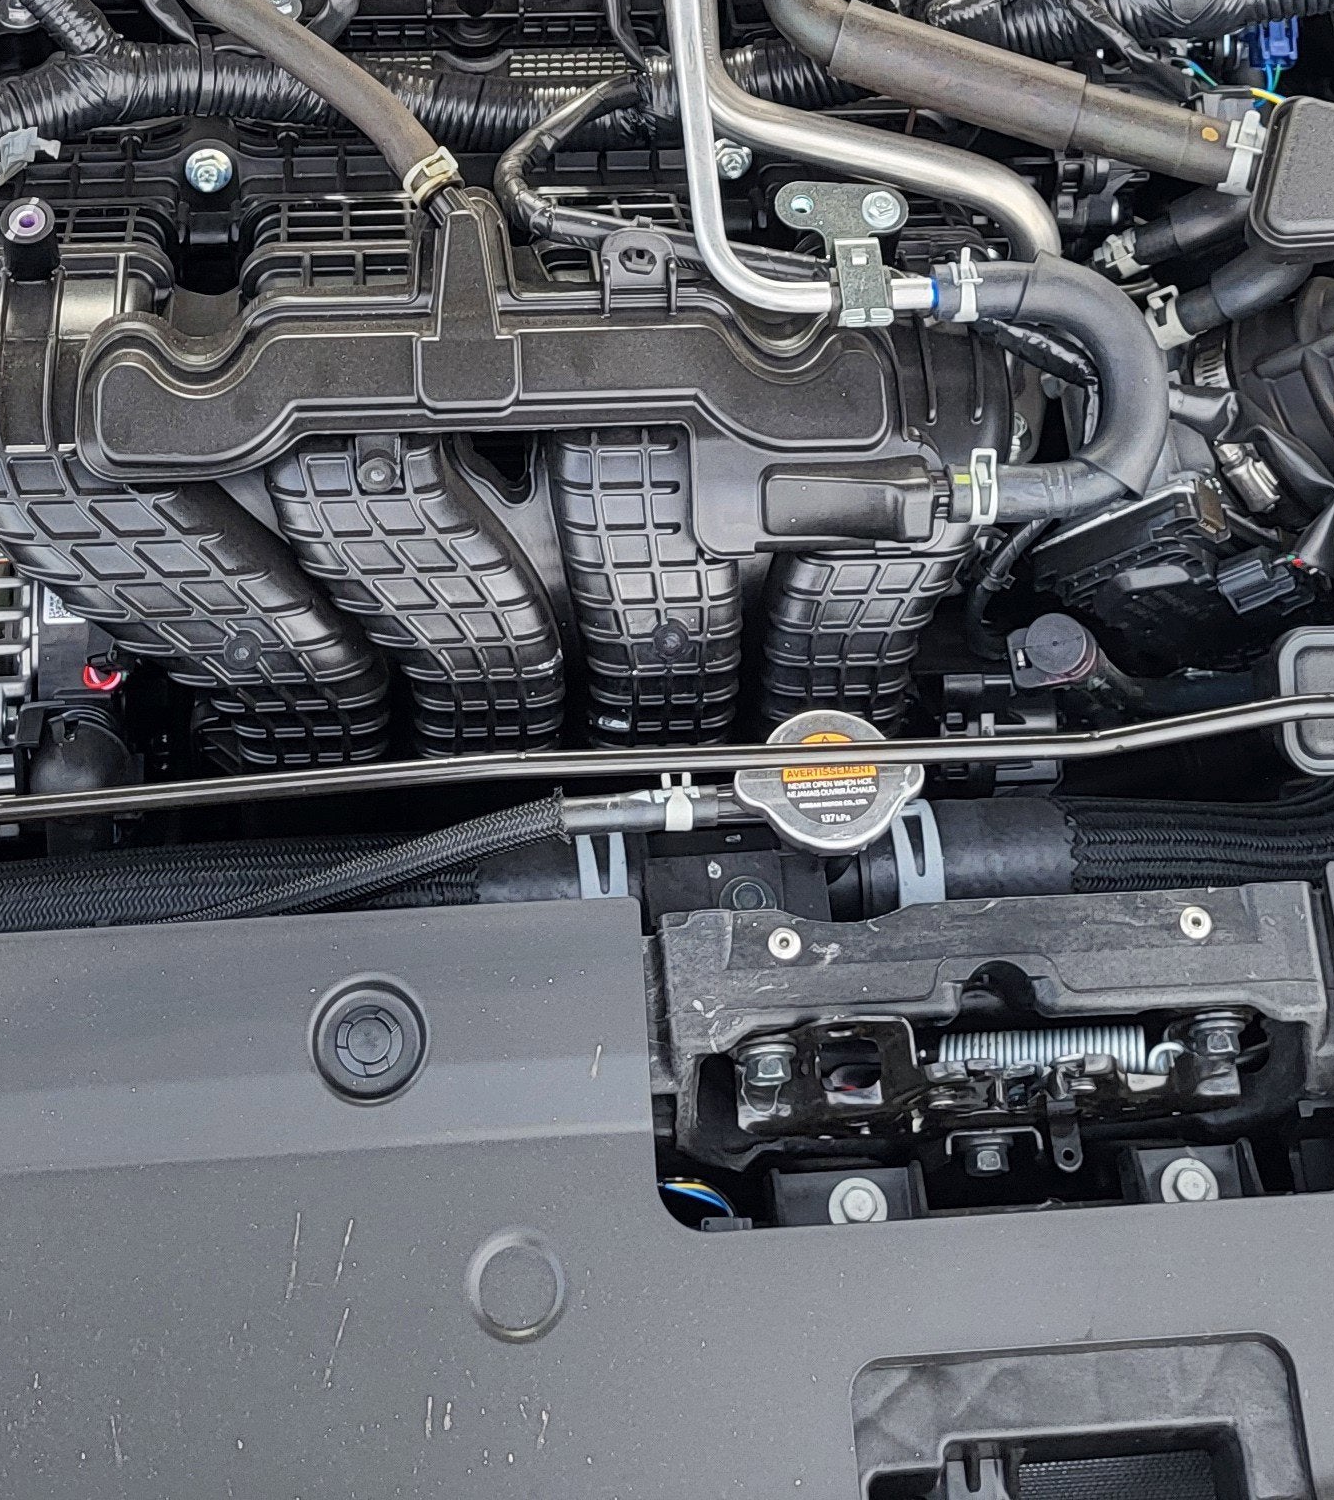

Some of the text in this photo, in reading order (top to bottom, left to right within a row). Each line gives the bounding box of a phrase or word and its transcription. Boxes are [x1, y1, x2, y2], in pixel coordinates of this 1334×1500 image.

[787, 765, 871, 779] AVERTISSEMENT
[787, 781, 812, 790] NEVER
[812, 780, 833, 788] OPEN
[834, 779, 856, 787] WHEN
